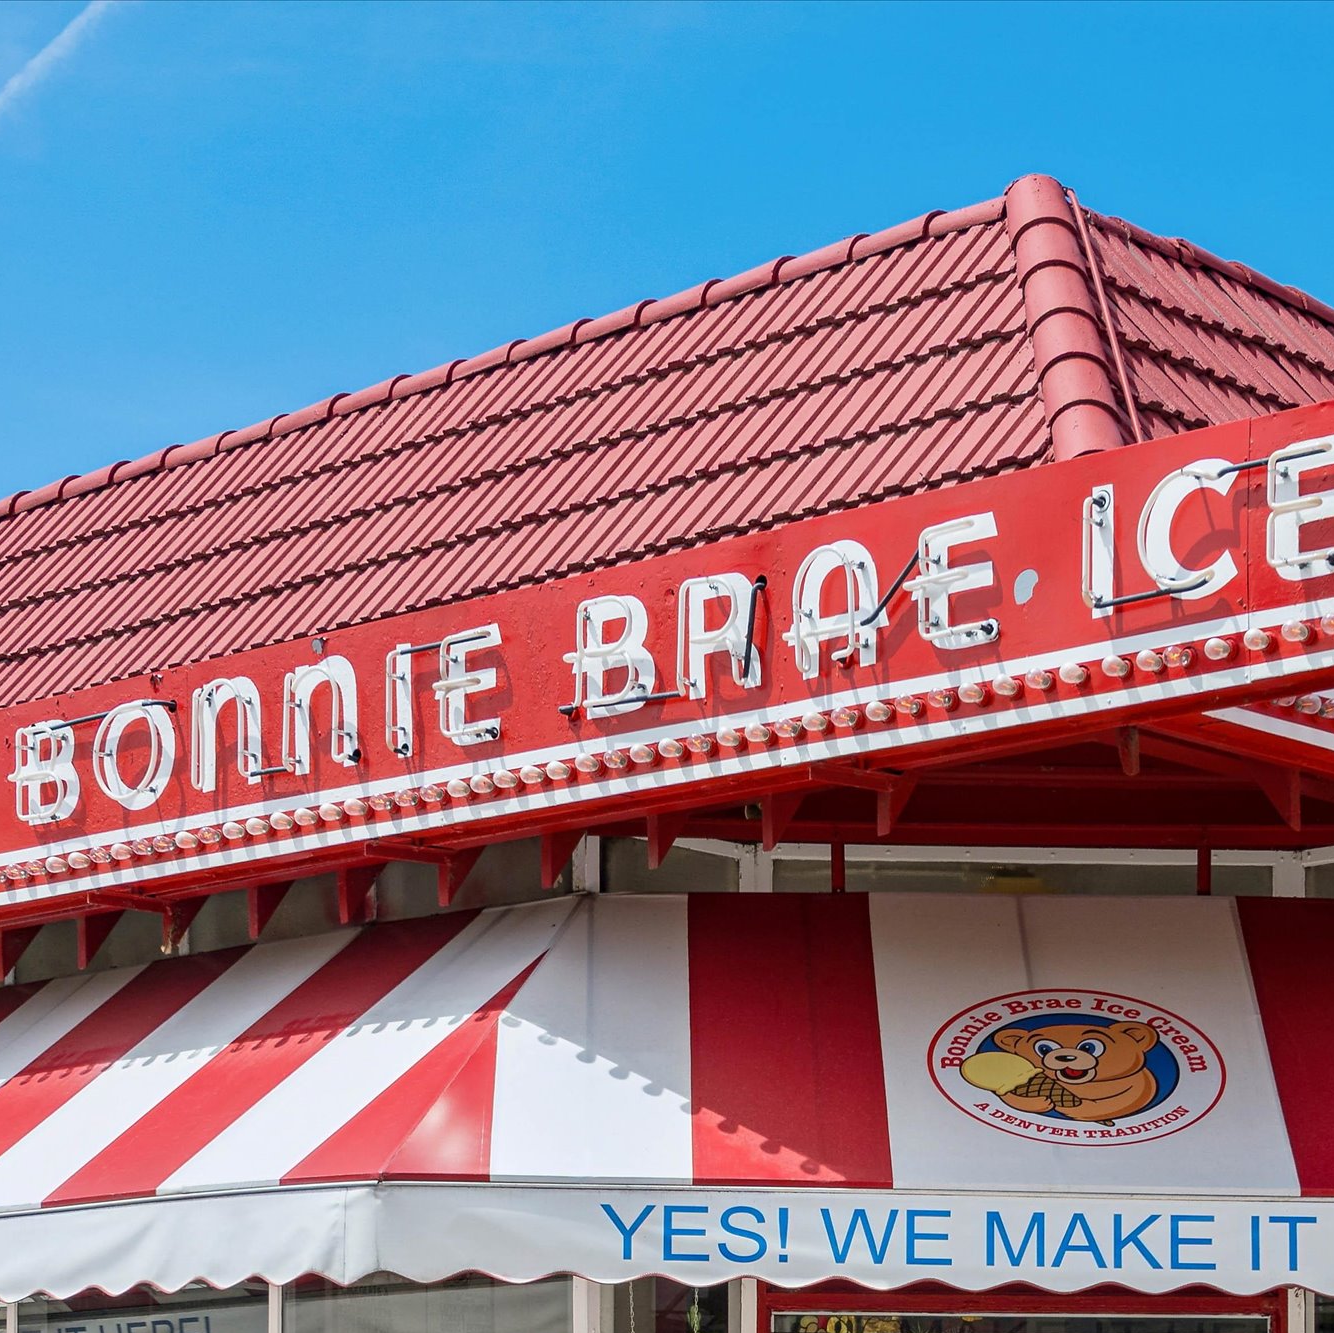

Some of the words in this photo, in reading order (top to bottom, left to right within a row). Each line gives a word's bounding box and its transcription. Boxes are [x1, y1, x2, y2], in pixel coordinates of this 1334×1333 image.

[7, 622, 503, 828] BONNIE
[561, 512, 999, 720] BRAE
[941, 1009, 1003, 1069] Bonnie
[1001, 997, 1082, 1017] Brae
[1090, 998, 1142, 1020] Ice
[1146, 1015, 1208, 1074] Cream
[973, 1101, 988, 1112] A
[989, 1108, 1079, 1138] DENVER
[1083, 1105, 1190, 1139] TRADITION
[599, 1203, 788, 1265] YES!
[820, 1207, 957, 1267] WE
[985, 1210, 1215, 1271] MAKE
[1250, 1214, 1317, 1272] IT
